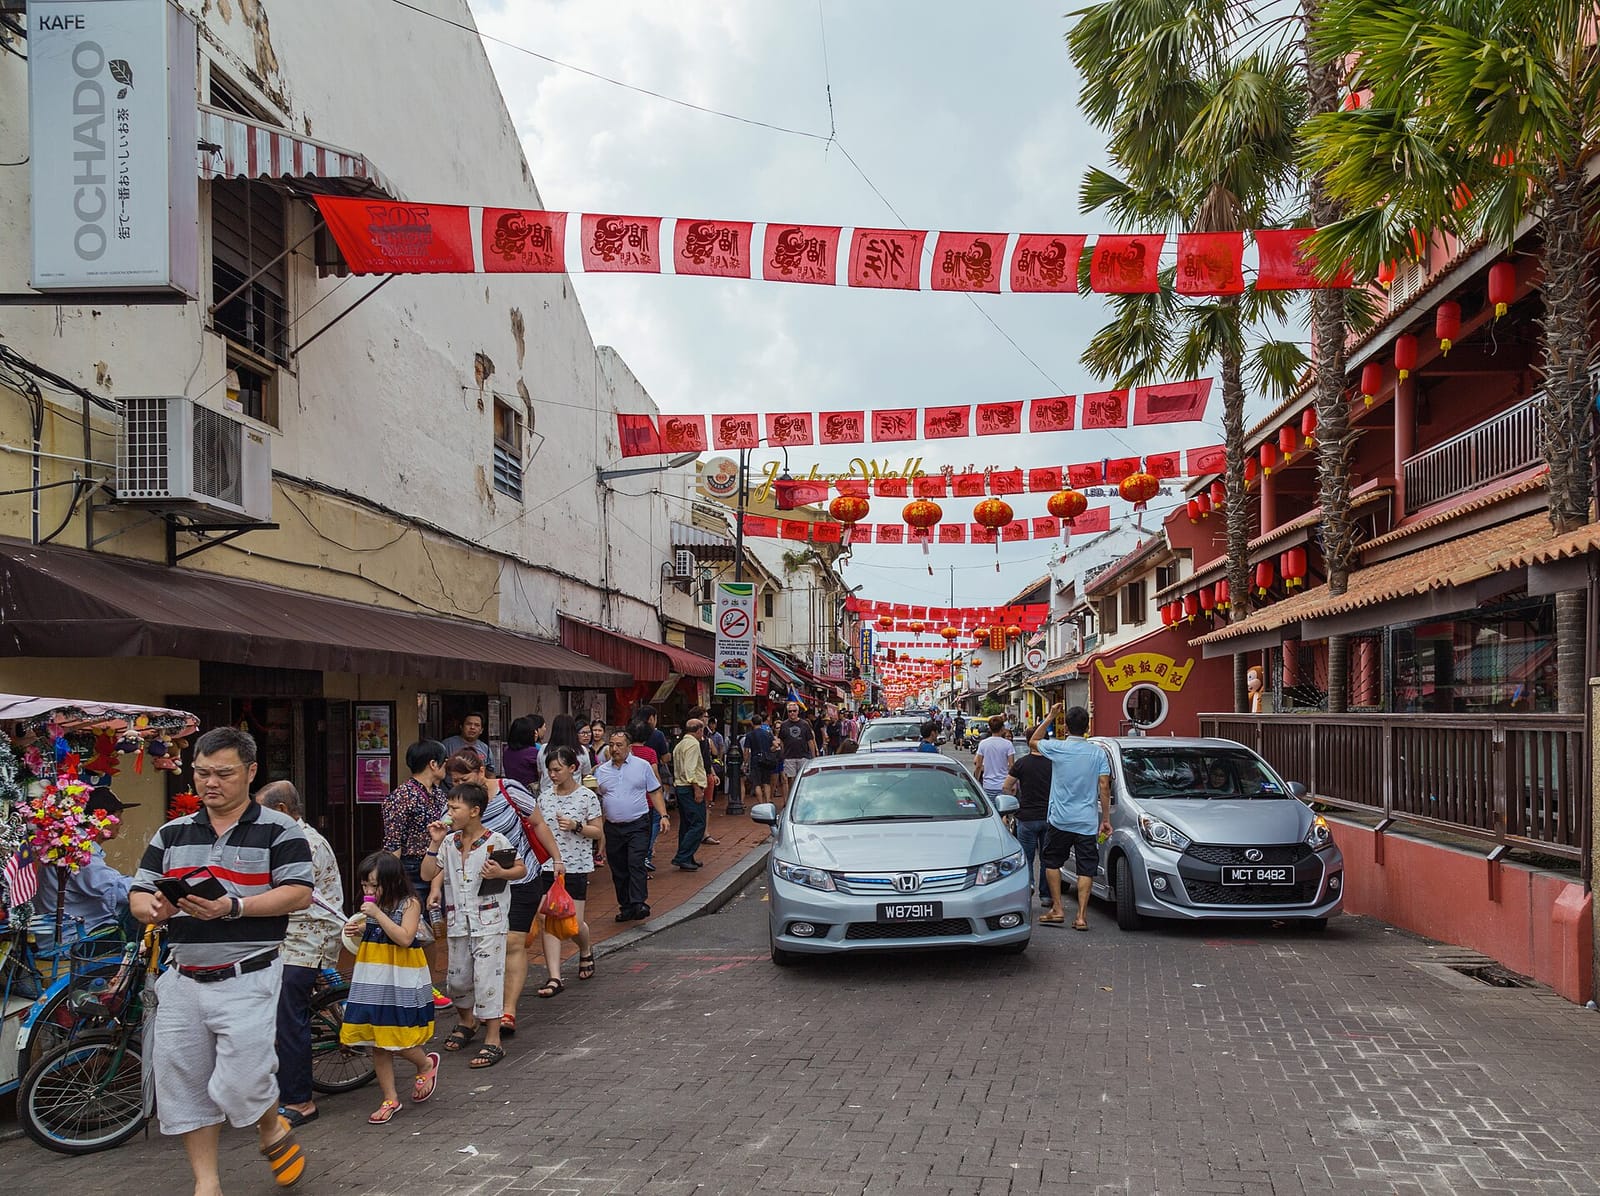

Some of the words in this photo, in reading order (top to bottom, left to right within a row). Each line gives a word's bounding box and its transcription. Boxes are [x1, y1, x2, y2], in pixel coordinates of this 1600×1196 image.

[39, 14, 86, 31] KAFE
[72, 40, 107, 261] OCHADO
[117, 107, 131, 240] 街で一番おいしいお茶
[1231, 869, 1253, 880] MCT
[1256, 869, 1286, 880] 8482
[885, 904, 933, 918] W8791H
